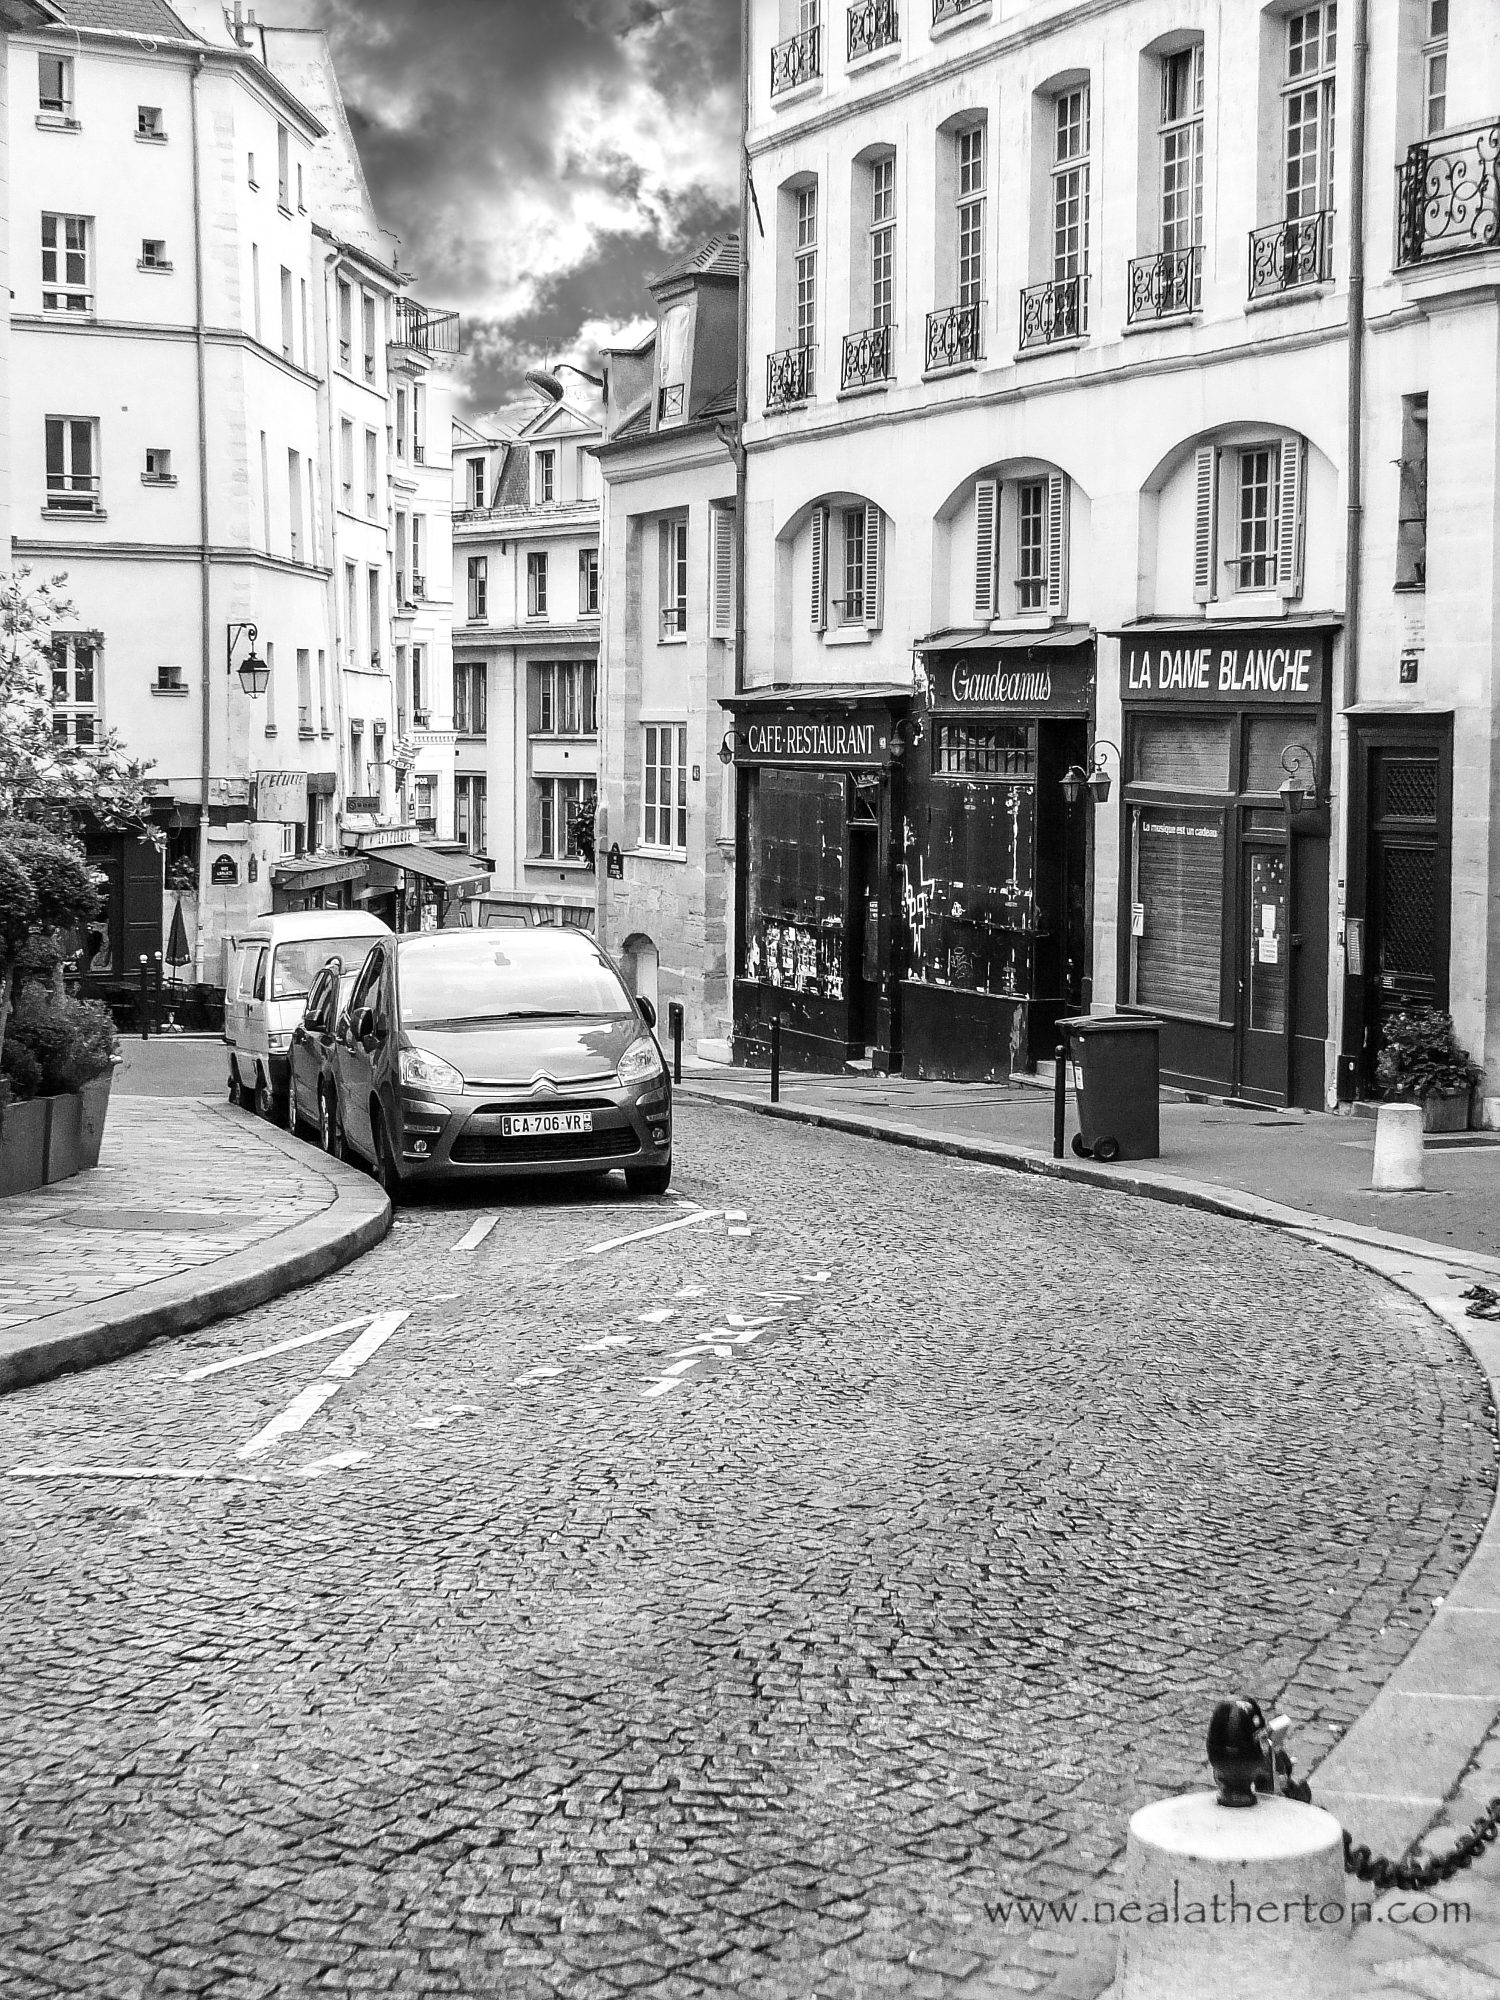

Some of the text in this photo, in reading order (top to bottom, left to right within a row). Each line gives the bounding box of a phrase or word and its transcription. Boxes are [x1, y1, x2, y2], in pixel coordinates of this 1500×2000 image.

[951, 659, 1051, 702] Gaudeamus
[1128, 648, 1312, 692] LA DAME BLANCHE
[1142, 821, 1150, 832] La
[1151, 823, 1176, 836] musique
[1186, 827, 1195, 836] un
[513, 1115, 582, 1133] CA-706-VR
